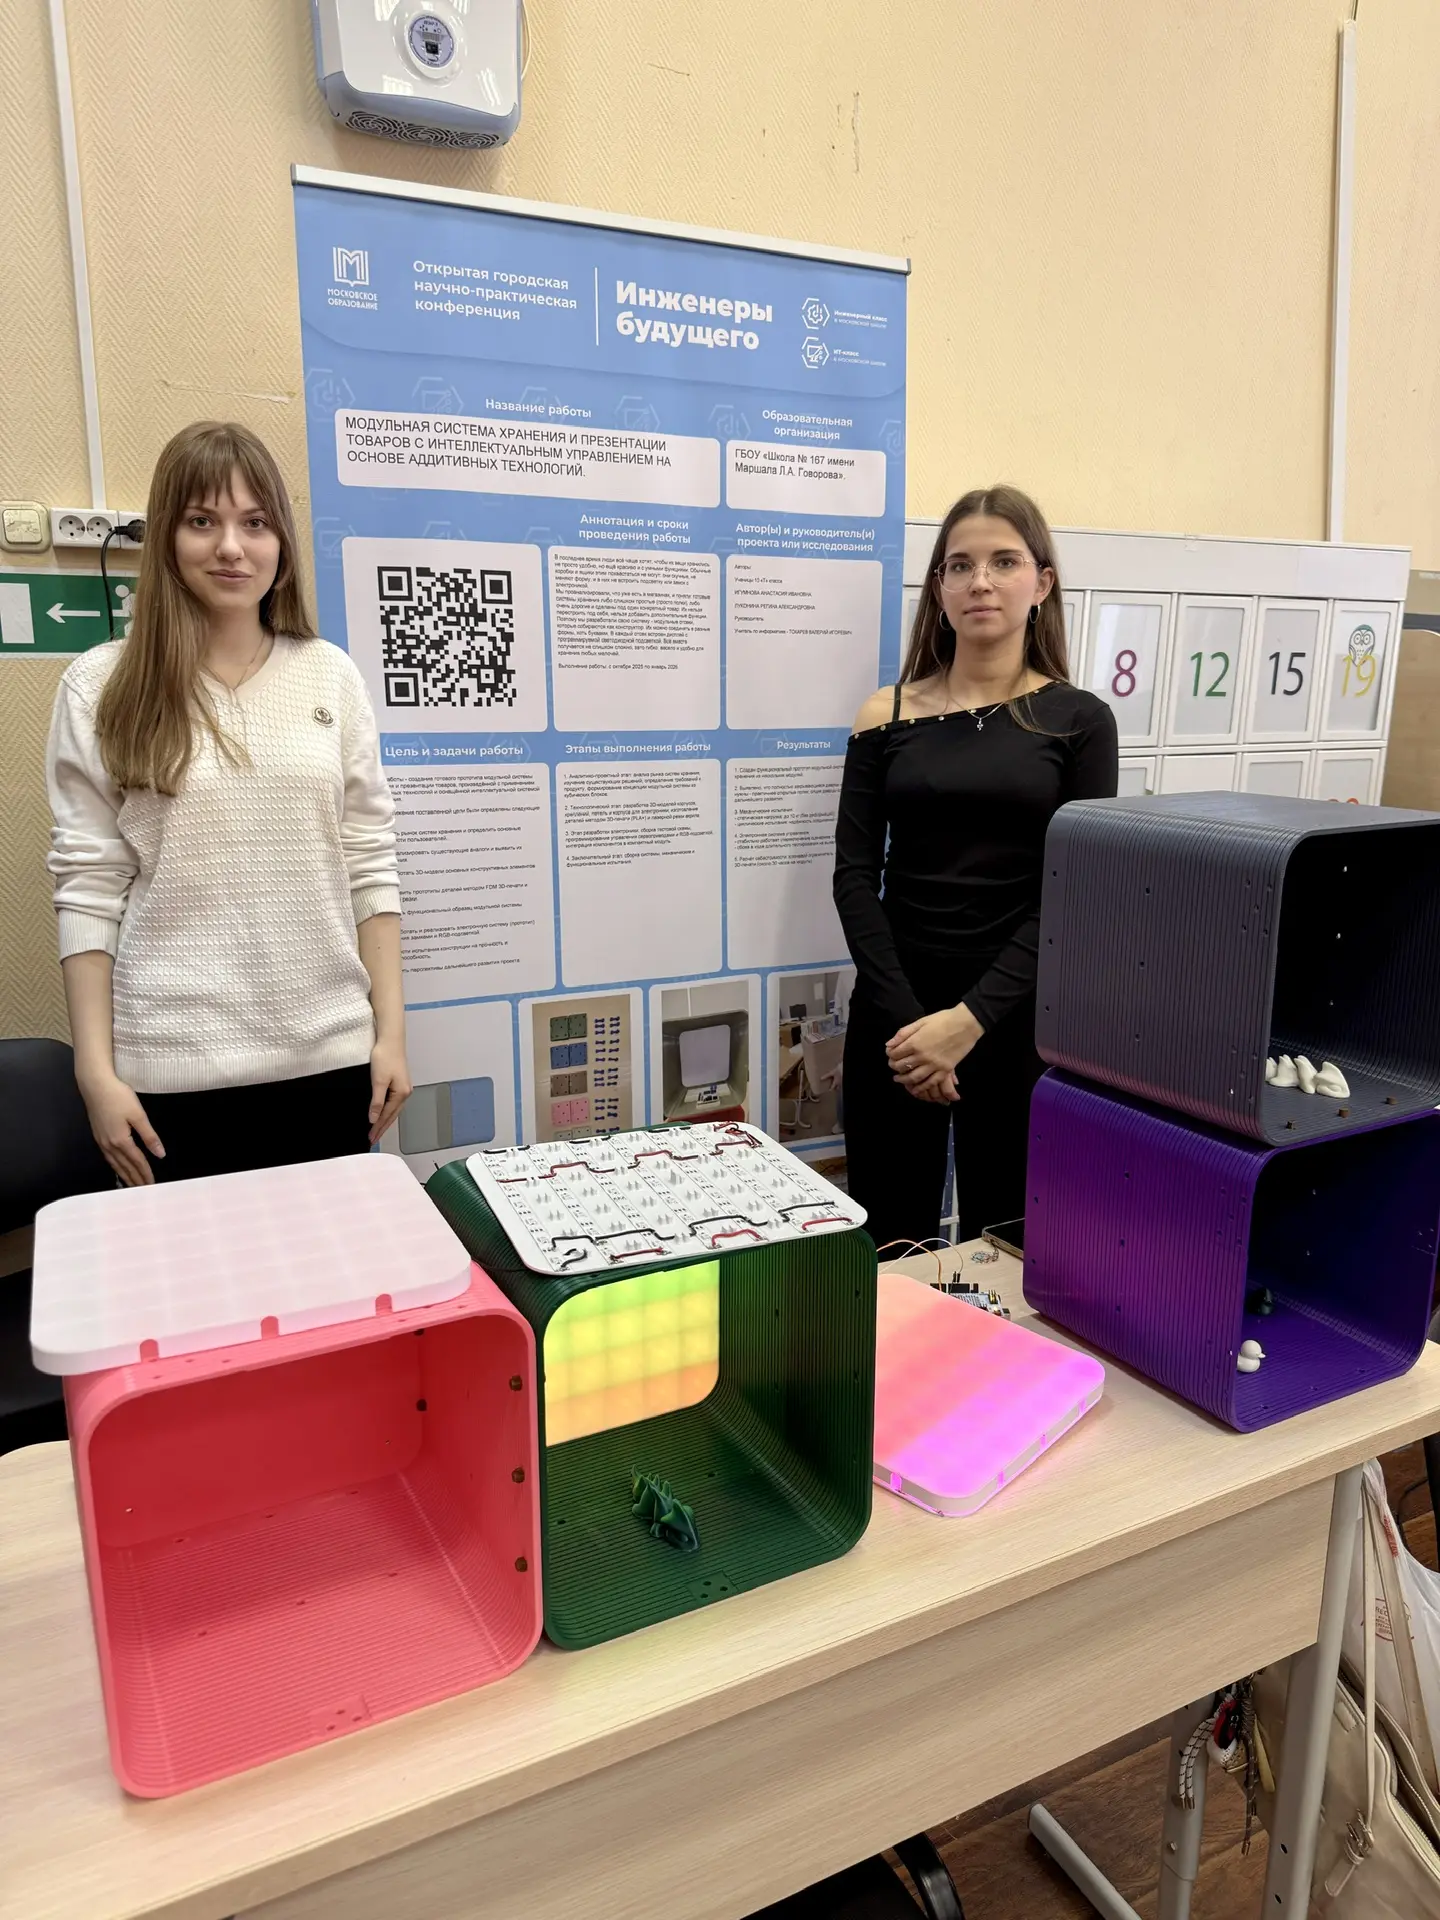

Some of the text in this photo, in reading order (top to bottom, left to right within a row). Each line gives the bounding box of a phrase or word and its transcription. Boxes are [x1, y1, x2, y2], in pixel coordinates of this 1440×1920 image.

[413, 260, 568, 290] Открытая городская
[328, 288, 377, 301] МОСКОВСКОЕ
[415, 281, 576, 309] научно-практическая
[617, 280, 772, 323] Инженеры
[328, 298, 377, 310] ОБРАЗОВАНИЕ
[416, 300, 520, 320] конференция
[616, 311, 759, 350] будущего
[486, 399, 591, 417] Название работы
[762, 410, 852, 427] Образовательная
[346, 417, 666, 452] МОДУЛЬНАЯ СИСТЕМА ХРАНЕНИЯ И ПРЕЗЕНТАЦИИ
[774, 427, 840, 440] организация
[346, 434, 671, 467] ТОВАРОВ С ИНТЕЛЛЕКТУАЛЬНЫМ УПРАВЛЕНИЕМ НА
[735, 448, 854, 466] ГБОУ «Школа № 167 имени
[347, 451, 585, 476] ОСНОВЕ АДДИТИВНЫХ ТЕХНОЛОГИЙ.
[735, 462, 846, 480] Маршала Л.А. Говорова».
[580, 514, 644, 527] Аннотация
[657, 520, 688, 530] сроки
[579, 530, 690, 543] проведения работы
[736, 523, 781, 536] Автор(ы)
[793, 528, 875, 540] руководитель(и)
[737, 539, 779, 548] проекта
[802, 542, 873, 551] исследования
[1111, 649, 1138, 698] 8
[1189, 651, 1231, 697] 12
[1268, 651, 1306, 696] 15
[1341, 653, 1377, 697] 19
[386, 745, 523, 758] Цель и задачи работы
[566, 742, 710, 753] Этапы выполнения работы
[777, 741, 830, 751] Результаты
